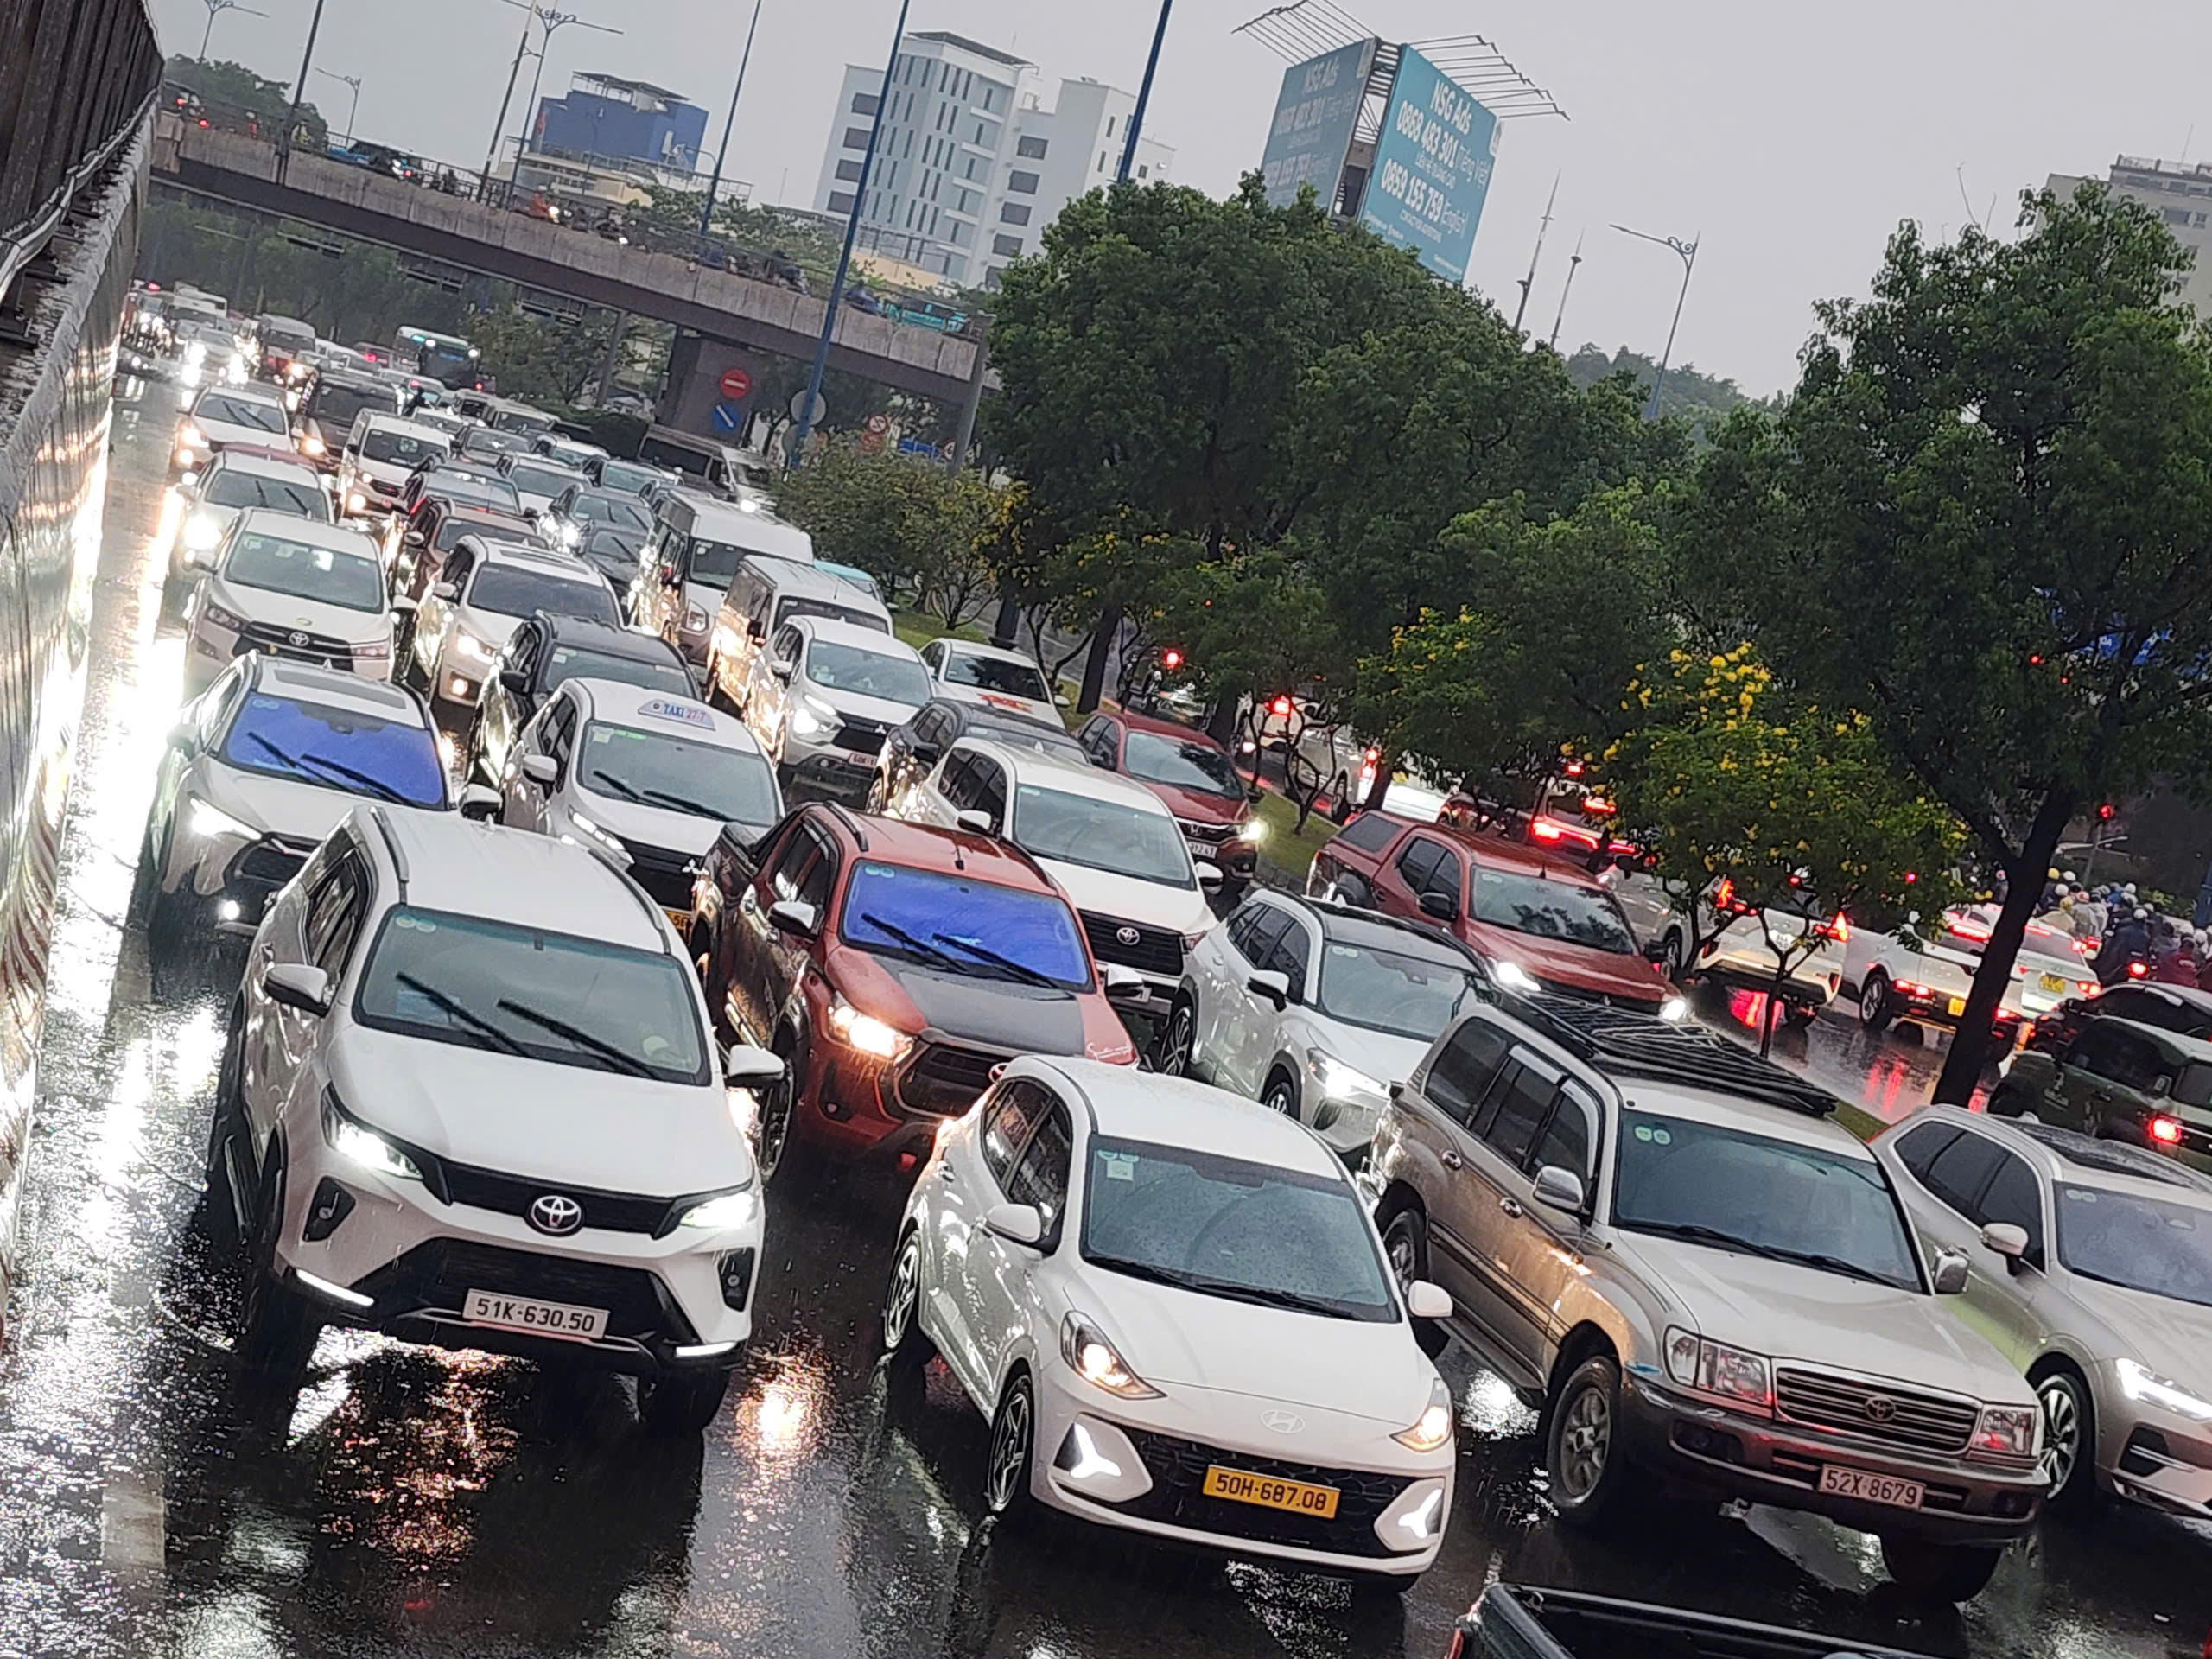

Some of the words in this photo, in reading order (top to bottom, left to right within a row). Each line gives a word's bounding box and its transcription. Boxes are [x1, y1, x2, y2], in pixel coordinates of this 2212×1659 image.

[1431, 79, 1456, 121] NSG
[1451, 97, 1472, 135] Ads
[1438, 130, 1459, 168] 301
[1381, 158, 1408, 200] 0859
[1404, 175, 1427, 212] 155
[1422, 186, 1444, 222] 759
[664, 703, 684, 718] TAXI
[476, 1298, 595, 1332] 51K-630.50
[1215, 1473, 1327, 1511] 50H-687.08
